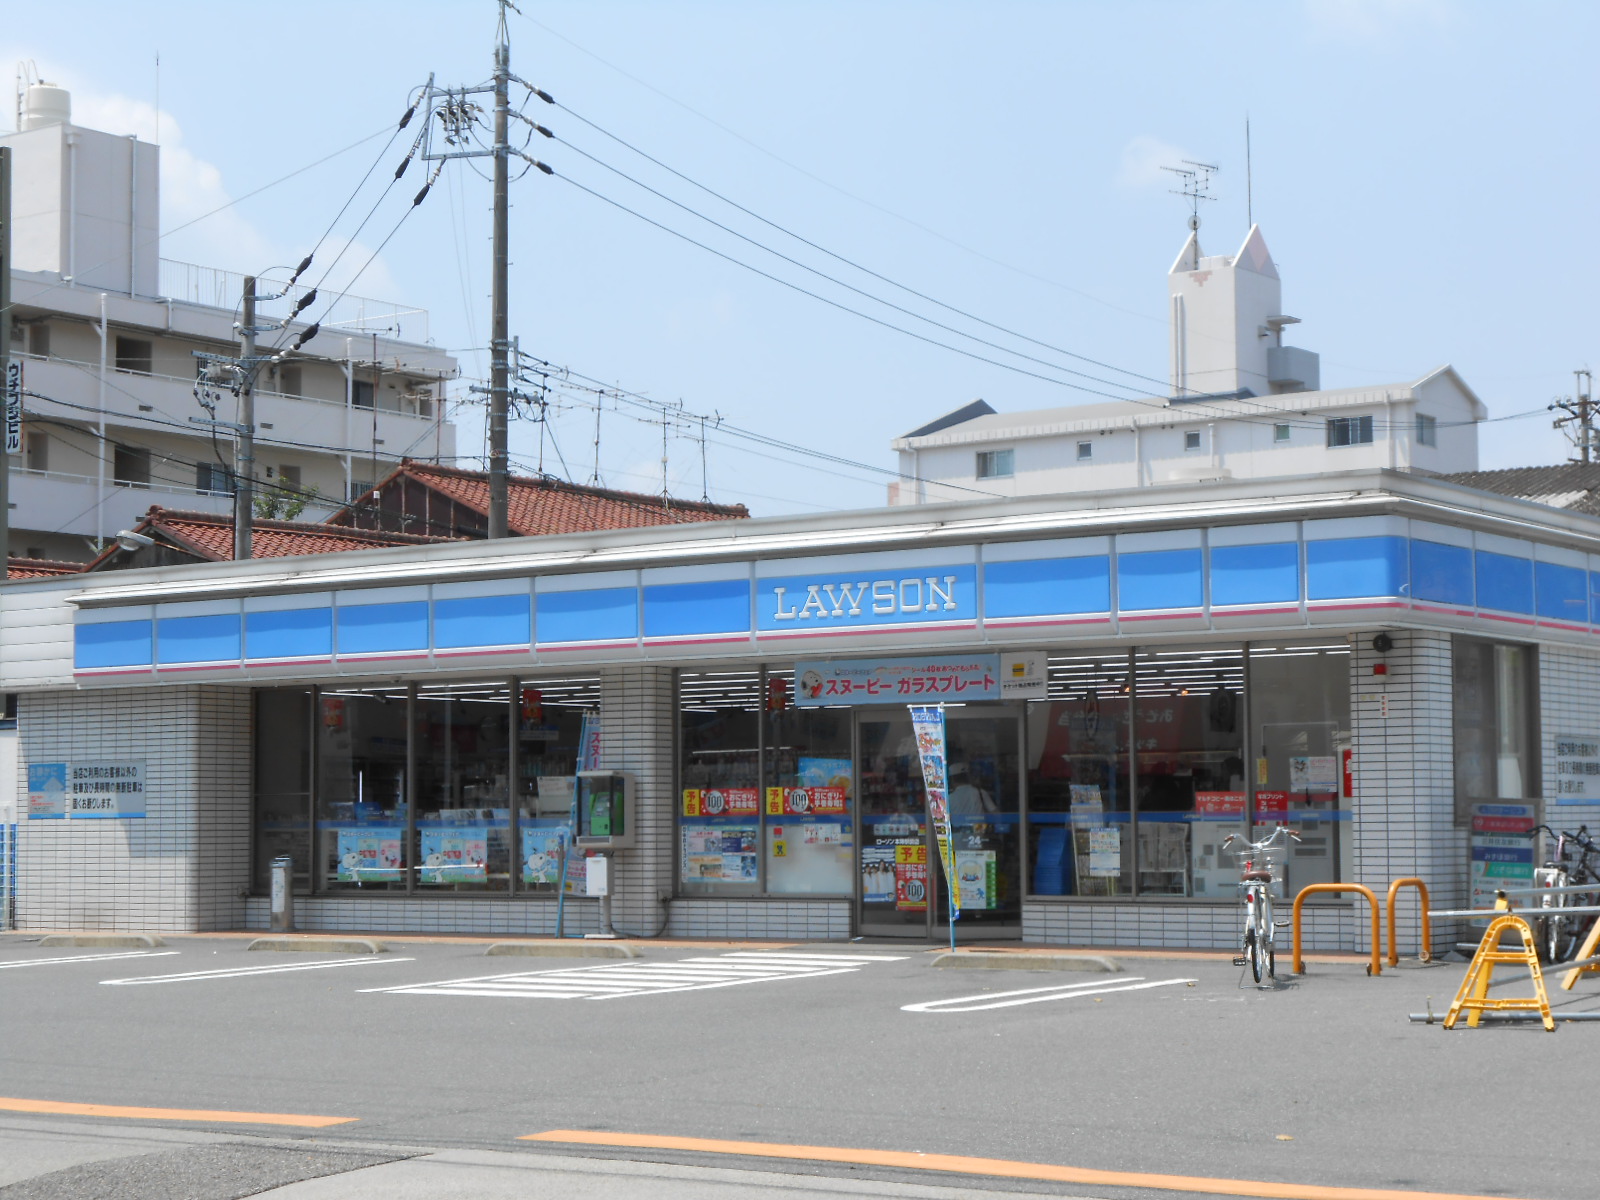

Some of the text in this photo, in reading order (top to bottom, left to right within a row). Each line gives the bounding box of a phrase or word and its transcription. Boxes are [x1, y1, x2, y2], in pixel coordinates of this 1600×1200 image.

[774, 575, 957, 621] LAWSON
[825, 673, 997, 696] スヌーピー ガラスプレート
[686, 791, 697, 815] 予告
[769, 789, 780, 813] 予告
[967, 834, 982, 845] 24
[900, 846, 927, 862] 予告
